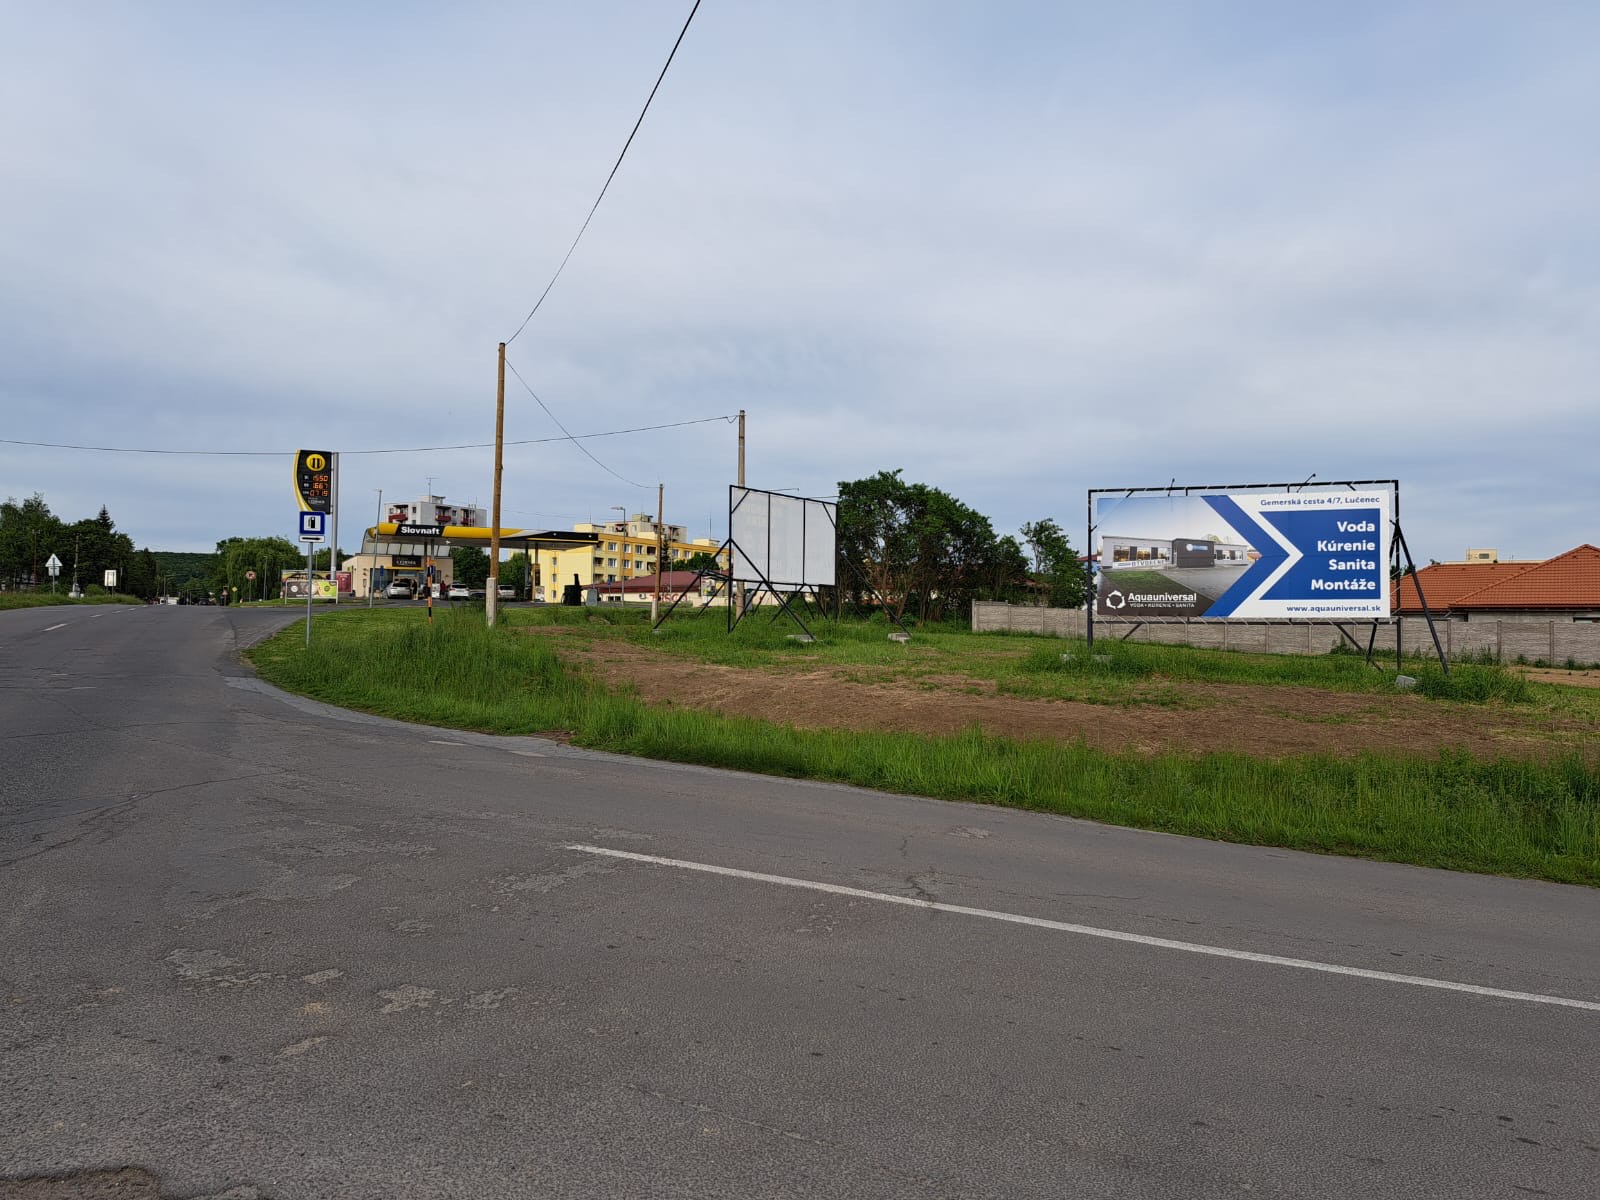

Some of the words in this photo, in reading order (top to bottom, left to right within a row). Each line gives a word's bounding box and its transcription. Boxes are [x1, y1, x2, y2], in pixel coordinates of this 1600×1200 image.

[1260, 498, 1302, 506] Gemerská
[1326, 497, 1343, 505] 4/7,
[1345, 496, 1381, 504] Lučenec
[400, 526, 440, 535] Slovnaft
[1337, 521, 1376, 533] Voda
[1317, 539, 1376, 552] Kúrenie
[1328, 558, 1376, 571] Sanita
[1310, 578, 1376, 591] Montáže
[1128, 592, 1197, 602] Aquauniversal
[1286, 605, 1381, 613] www.aquauniversal.sk
